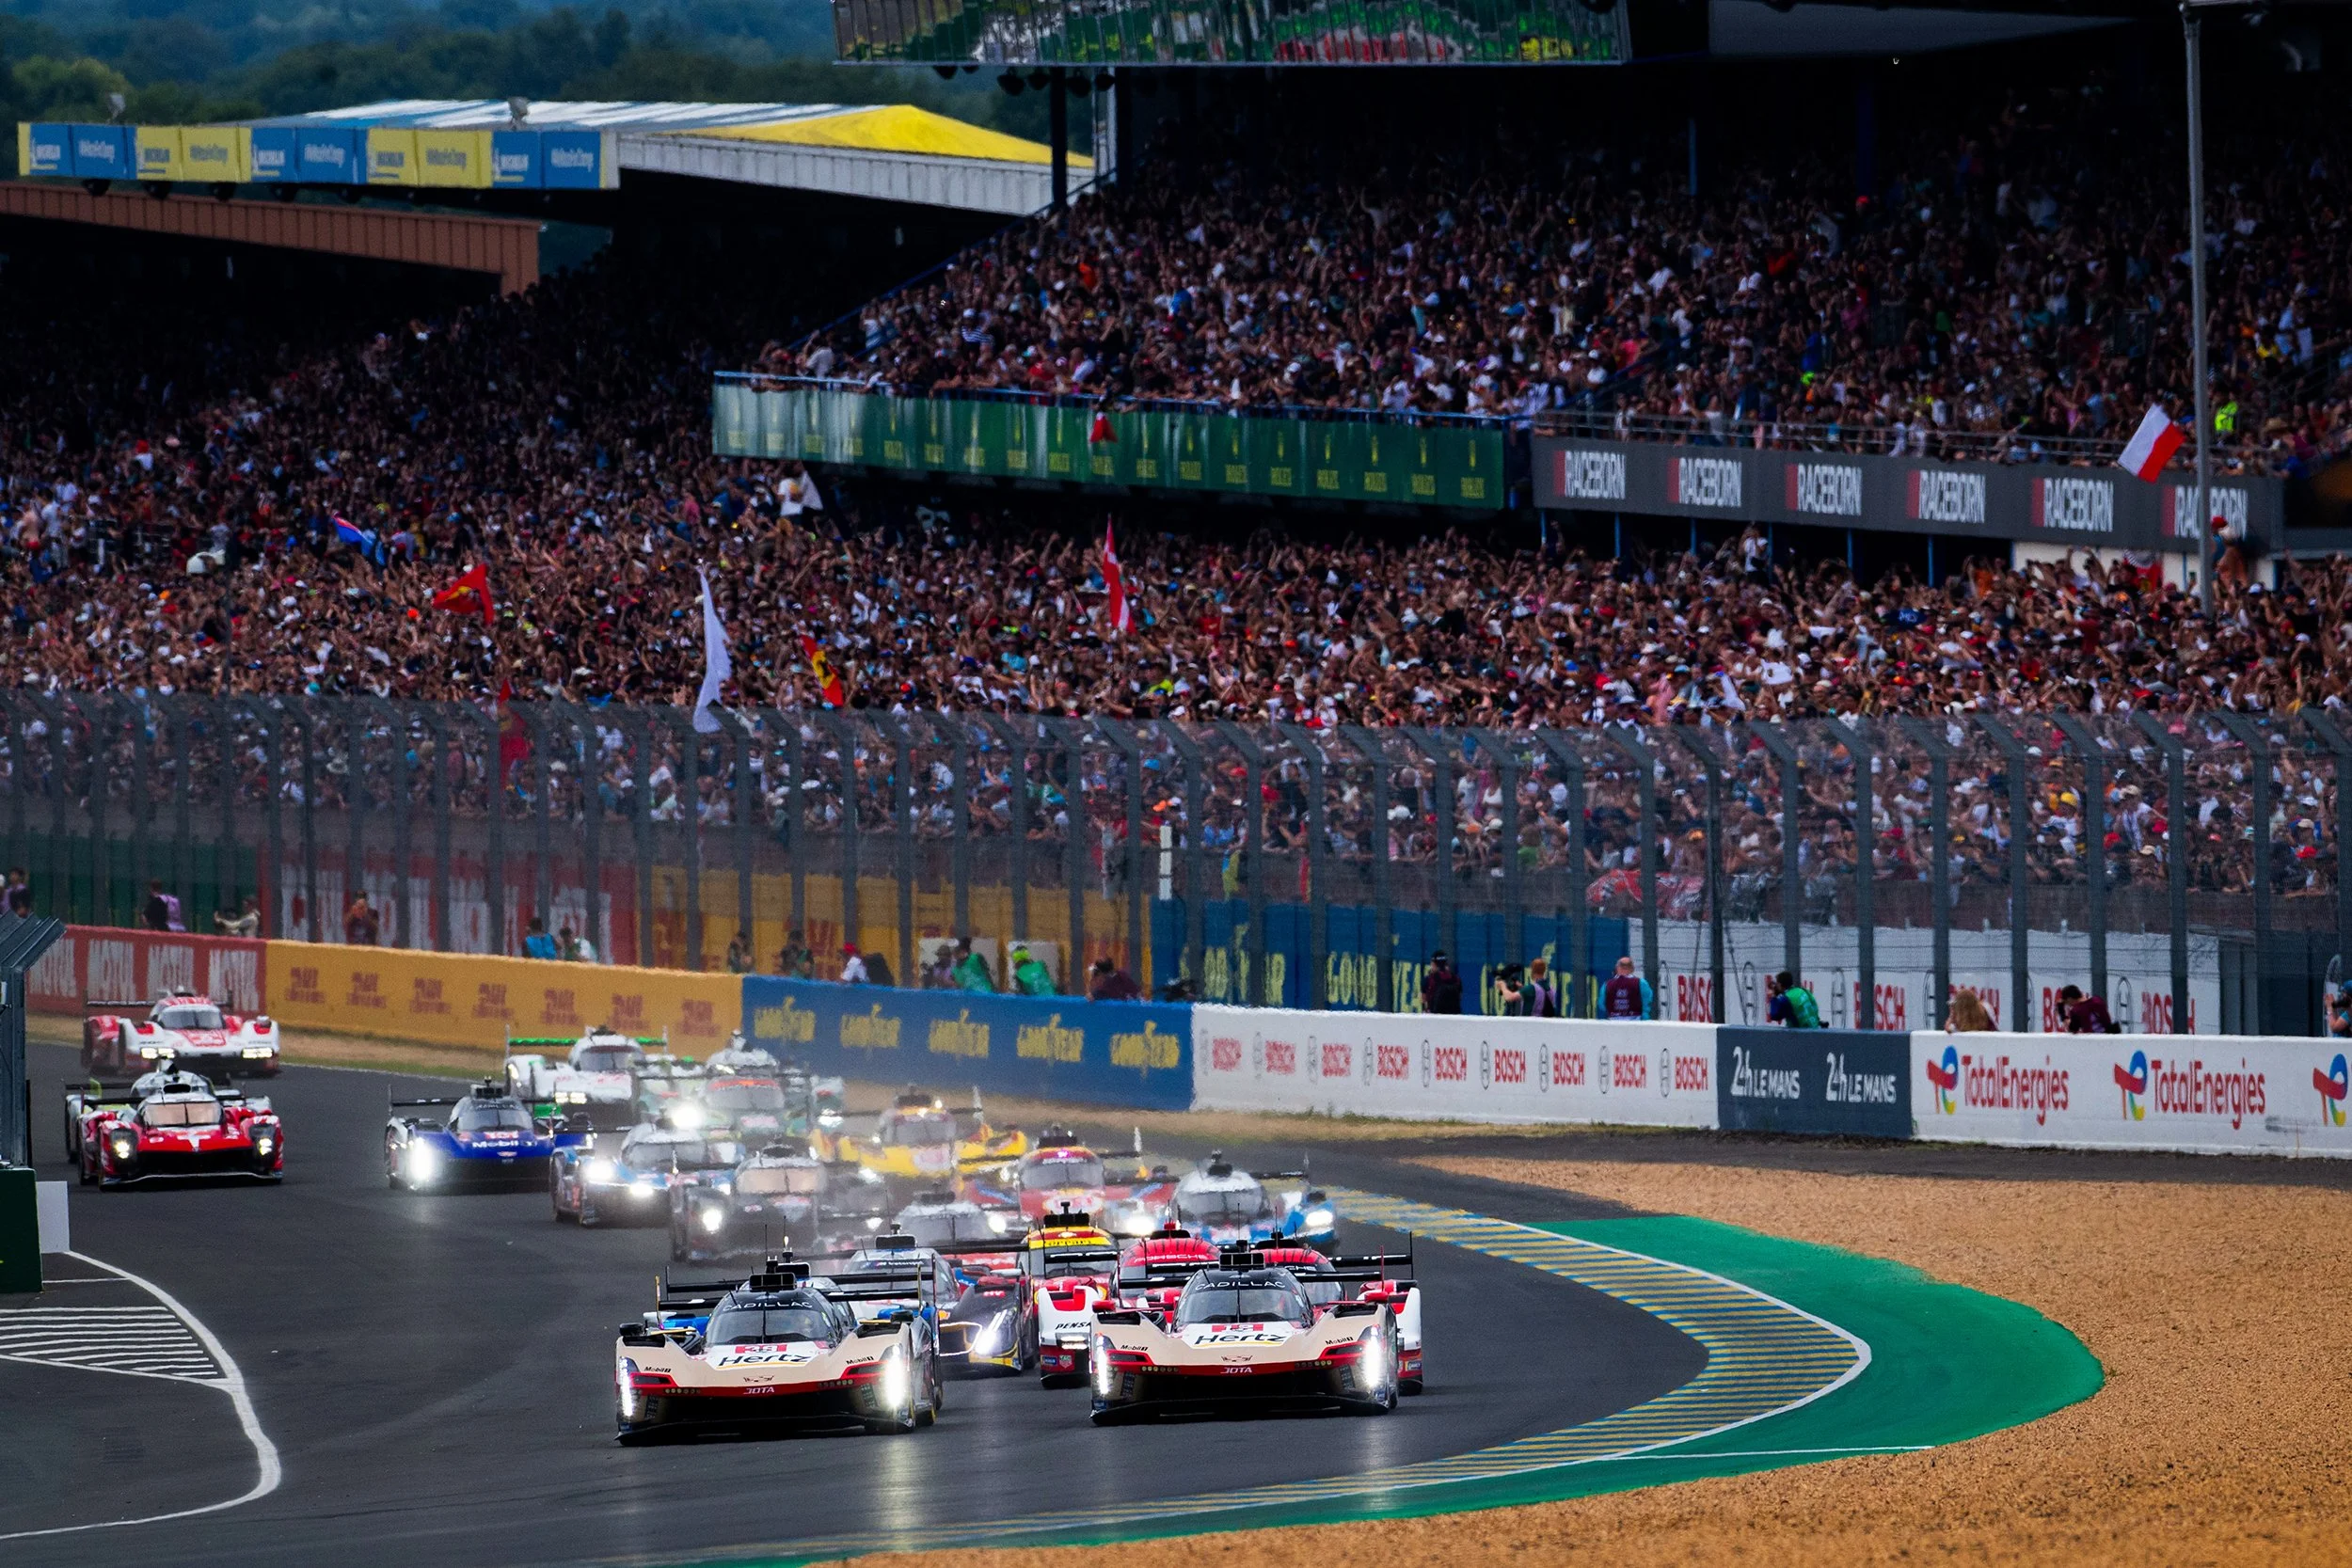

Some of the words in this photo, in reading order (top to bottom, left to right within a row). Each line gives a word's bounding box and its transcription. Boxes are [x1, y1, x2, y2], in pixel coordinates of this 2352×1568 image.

[1565, 451, 1626, 499] RACEBORN
[1678, 457, 1742, 508] RACEBORN
[1797, 464, 1862, 515] RACEBORN
[1918, 470, 1986, 523] RACEBORN
[2043, 478, 2113, 532] RACEBORN
[1435, 1047, 1467, 1081] BOSCH
[1494, 1049, 1526, 1083] BOSCH
[1552, 1052, 1584, 1085] BOSCH
[1613, 1054, 1646, 1088] BOSCH
[1676, 1056, 1708, 1091] BOSCH
[1754, 1069, 1768, 1098] LE
[1769, 1069, 1801, 1100] MANS
[1848, 1074, 1862, 1102] LE
[1863, 1074, 1897, 1104] MANS
[1962, 1054, 2069, 1126] TotalEnergies
[2151, 1058, 2266, 1131] TotalEnergies
[1134, 1254, 1208, 1263] PORSCHE
[1195, 1281, 1285, 1291] CADILLAC
[723, 1301, 813, 1311] CADILLAC
[1194, 1333, 1287, 1344] Hertz
[719, 1354, 811, 1367] Hertz
[846, 1356, 867, 1365] Mobil
[743, 1386, 774, 1395] JOTA
